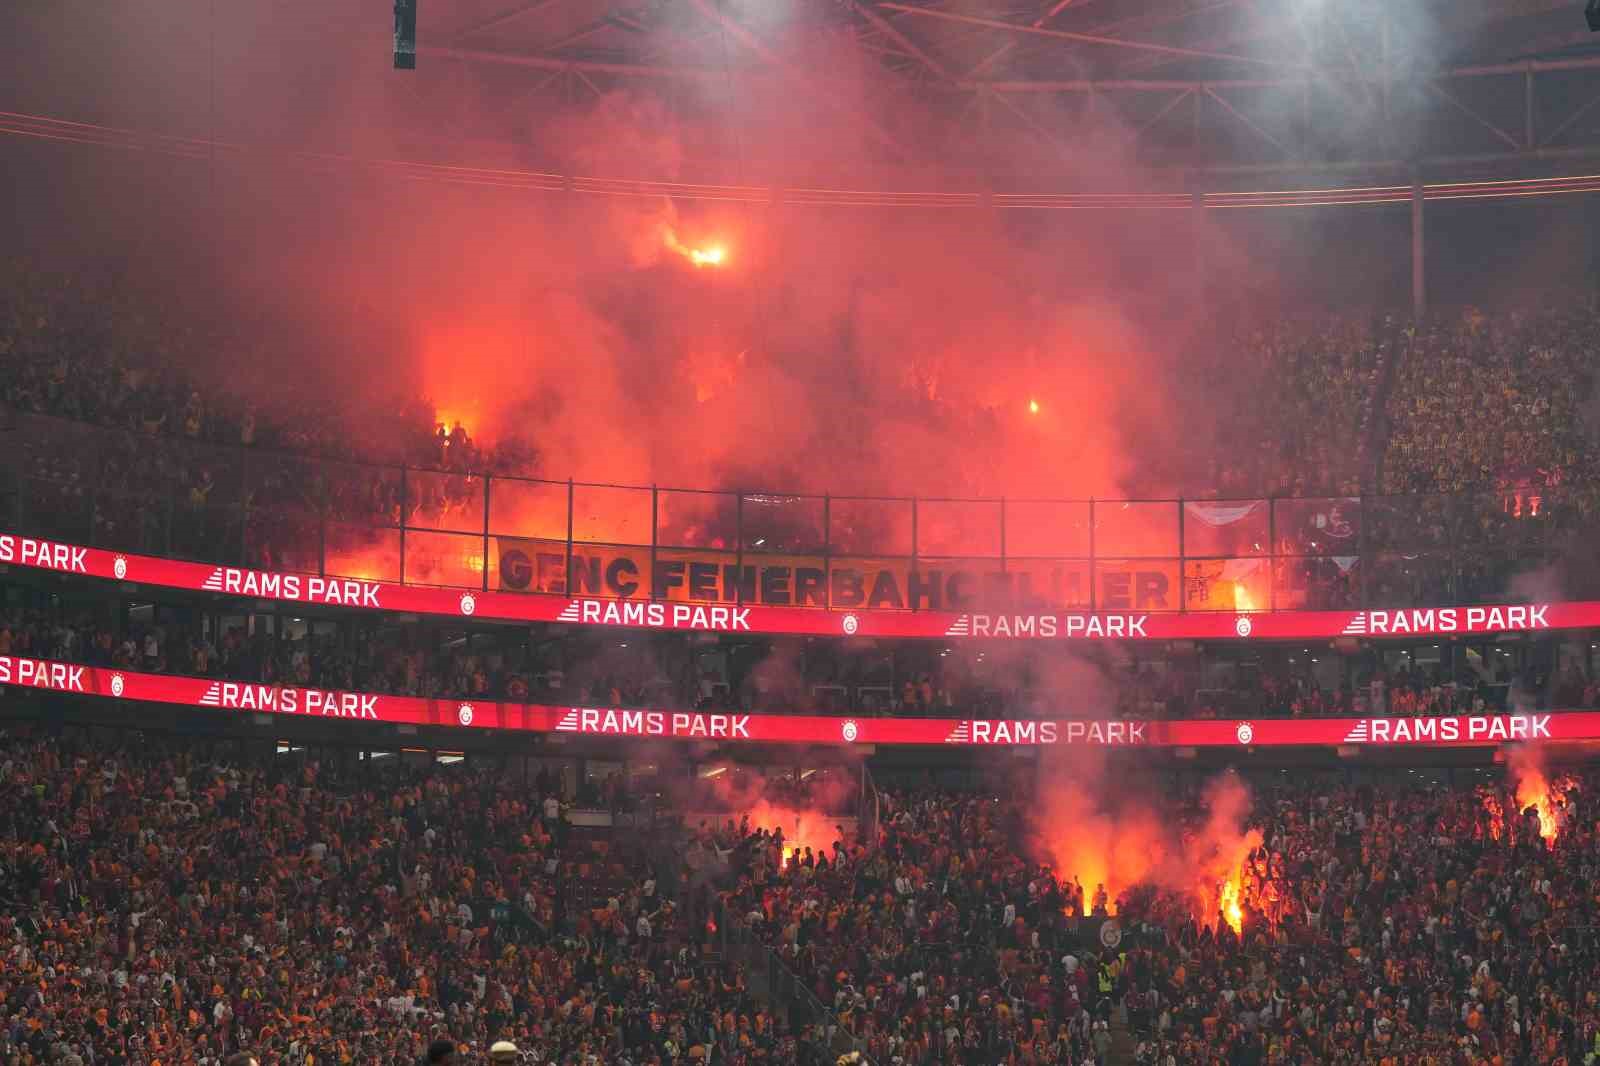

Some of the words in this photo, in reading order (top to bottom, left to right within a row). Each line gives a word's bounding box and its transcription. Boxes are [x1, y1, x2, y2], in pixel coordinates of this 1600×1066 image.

[21, 539, 88, 573] PARK
[225, 568, 300, 599] RAMS
[308, 578, 381, 607] PARK
[582, 600, 665, 627] RAMS
[673, 605, 752, 631] PARK
[972, 615, 1057, 637] RAMS
[1066, 615, 1148, 637] PARK
[1369, 608, 1458, 633] RAMS
[1467, 605, 1550, 630] PARK
[18, 660, 86, 692] PARK
[222, 683, 298, 713] RAMS
[305, 690, 379, 719] PARK
[581, 708, 664, 735] RAMS
[672, 713, 751, 738] PARK
[972, 721, 1057, 744] RAMS
[1066, 721, 1147, 744] PARK
[1371, 717, 1460, 742] RAMS
[1468, 714, 1552, 740] PARK
